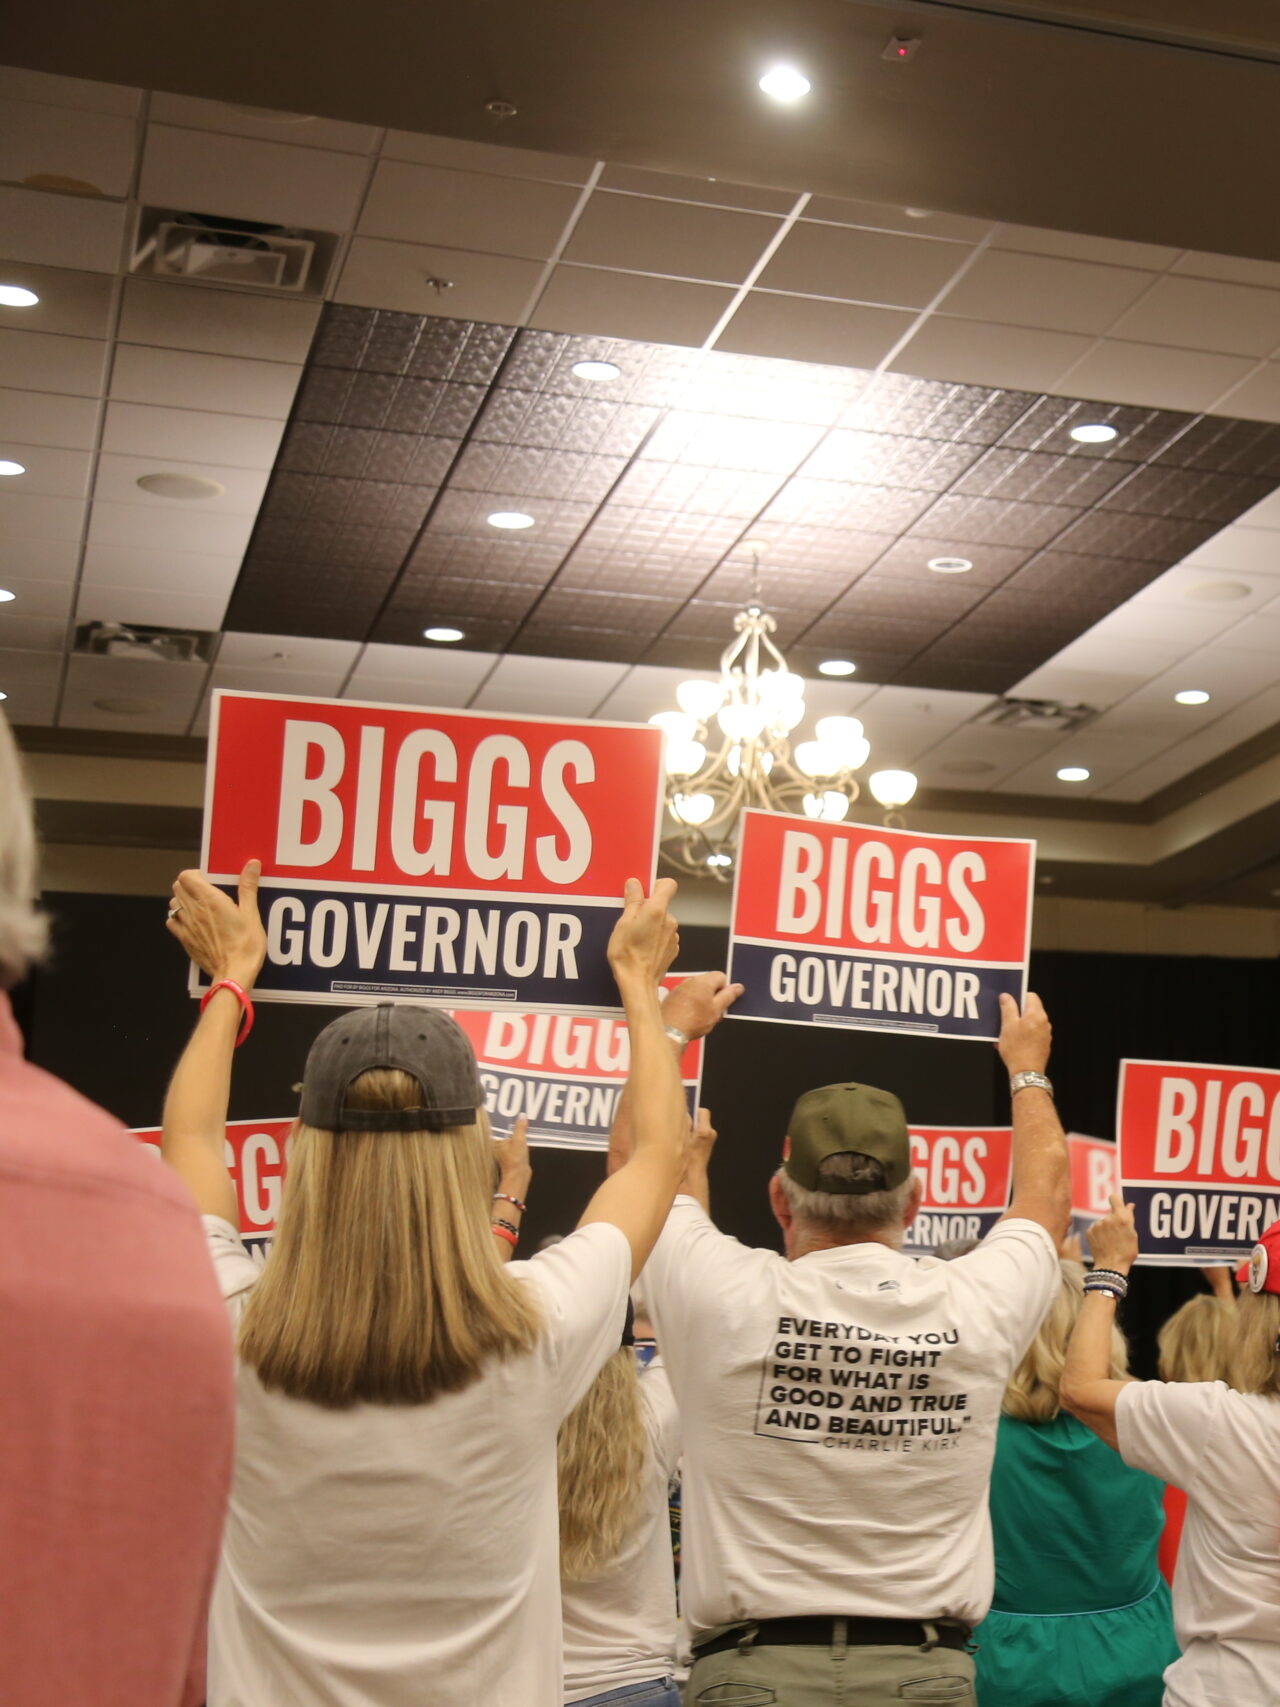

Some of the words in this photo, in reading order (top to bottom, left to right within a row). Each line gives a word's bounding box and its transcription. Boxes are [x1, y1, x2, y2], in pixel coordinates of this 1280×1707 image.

[274, 719, 597, 886] BIGGS
[775, 829, 987, 953] BIGGS
[266, 896, 584, 981] GOVERNOR
[769, 953, 980, 1020] GOVERNOR
[907, 1328, 959, 1345] YOU
[774, 1341, 822, 1361] GET
[830, 1345, 862, 1364] TO
[869, 1348, 942, 1368] FIGHT
[773, 1364, 822, 1384] FOR
[829, 1369, 903, 1390] WHAT
[908, 1373, 930, 1390] IS
[770, 1385, 844, 1409] GOOD
[850, 1395, 902, 1413] AND
[909, 1394, 967, 1412] TRUE
[765, 1409, 820, 1431] AND
[822, 1436, 913, 1453] CHARLIE
[921, 1436, 961, 1452] KIRK
